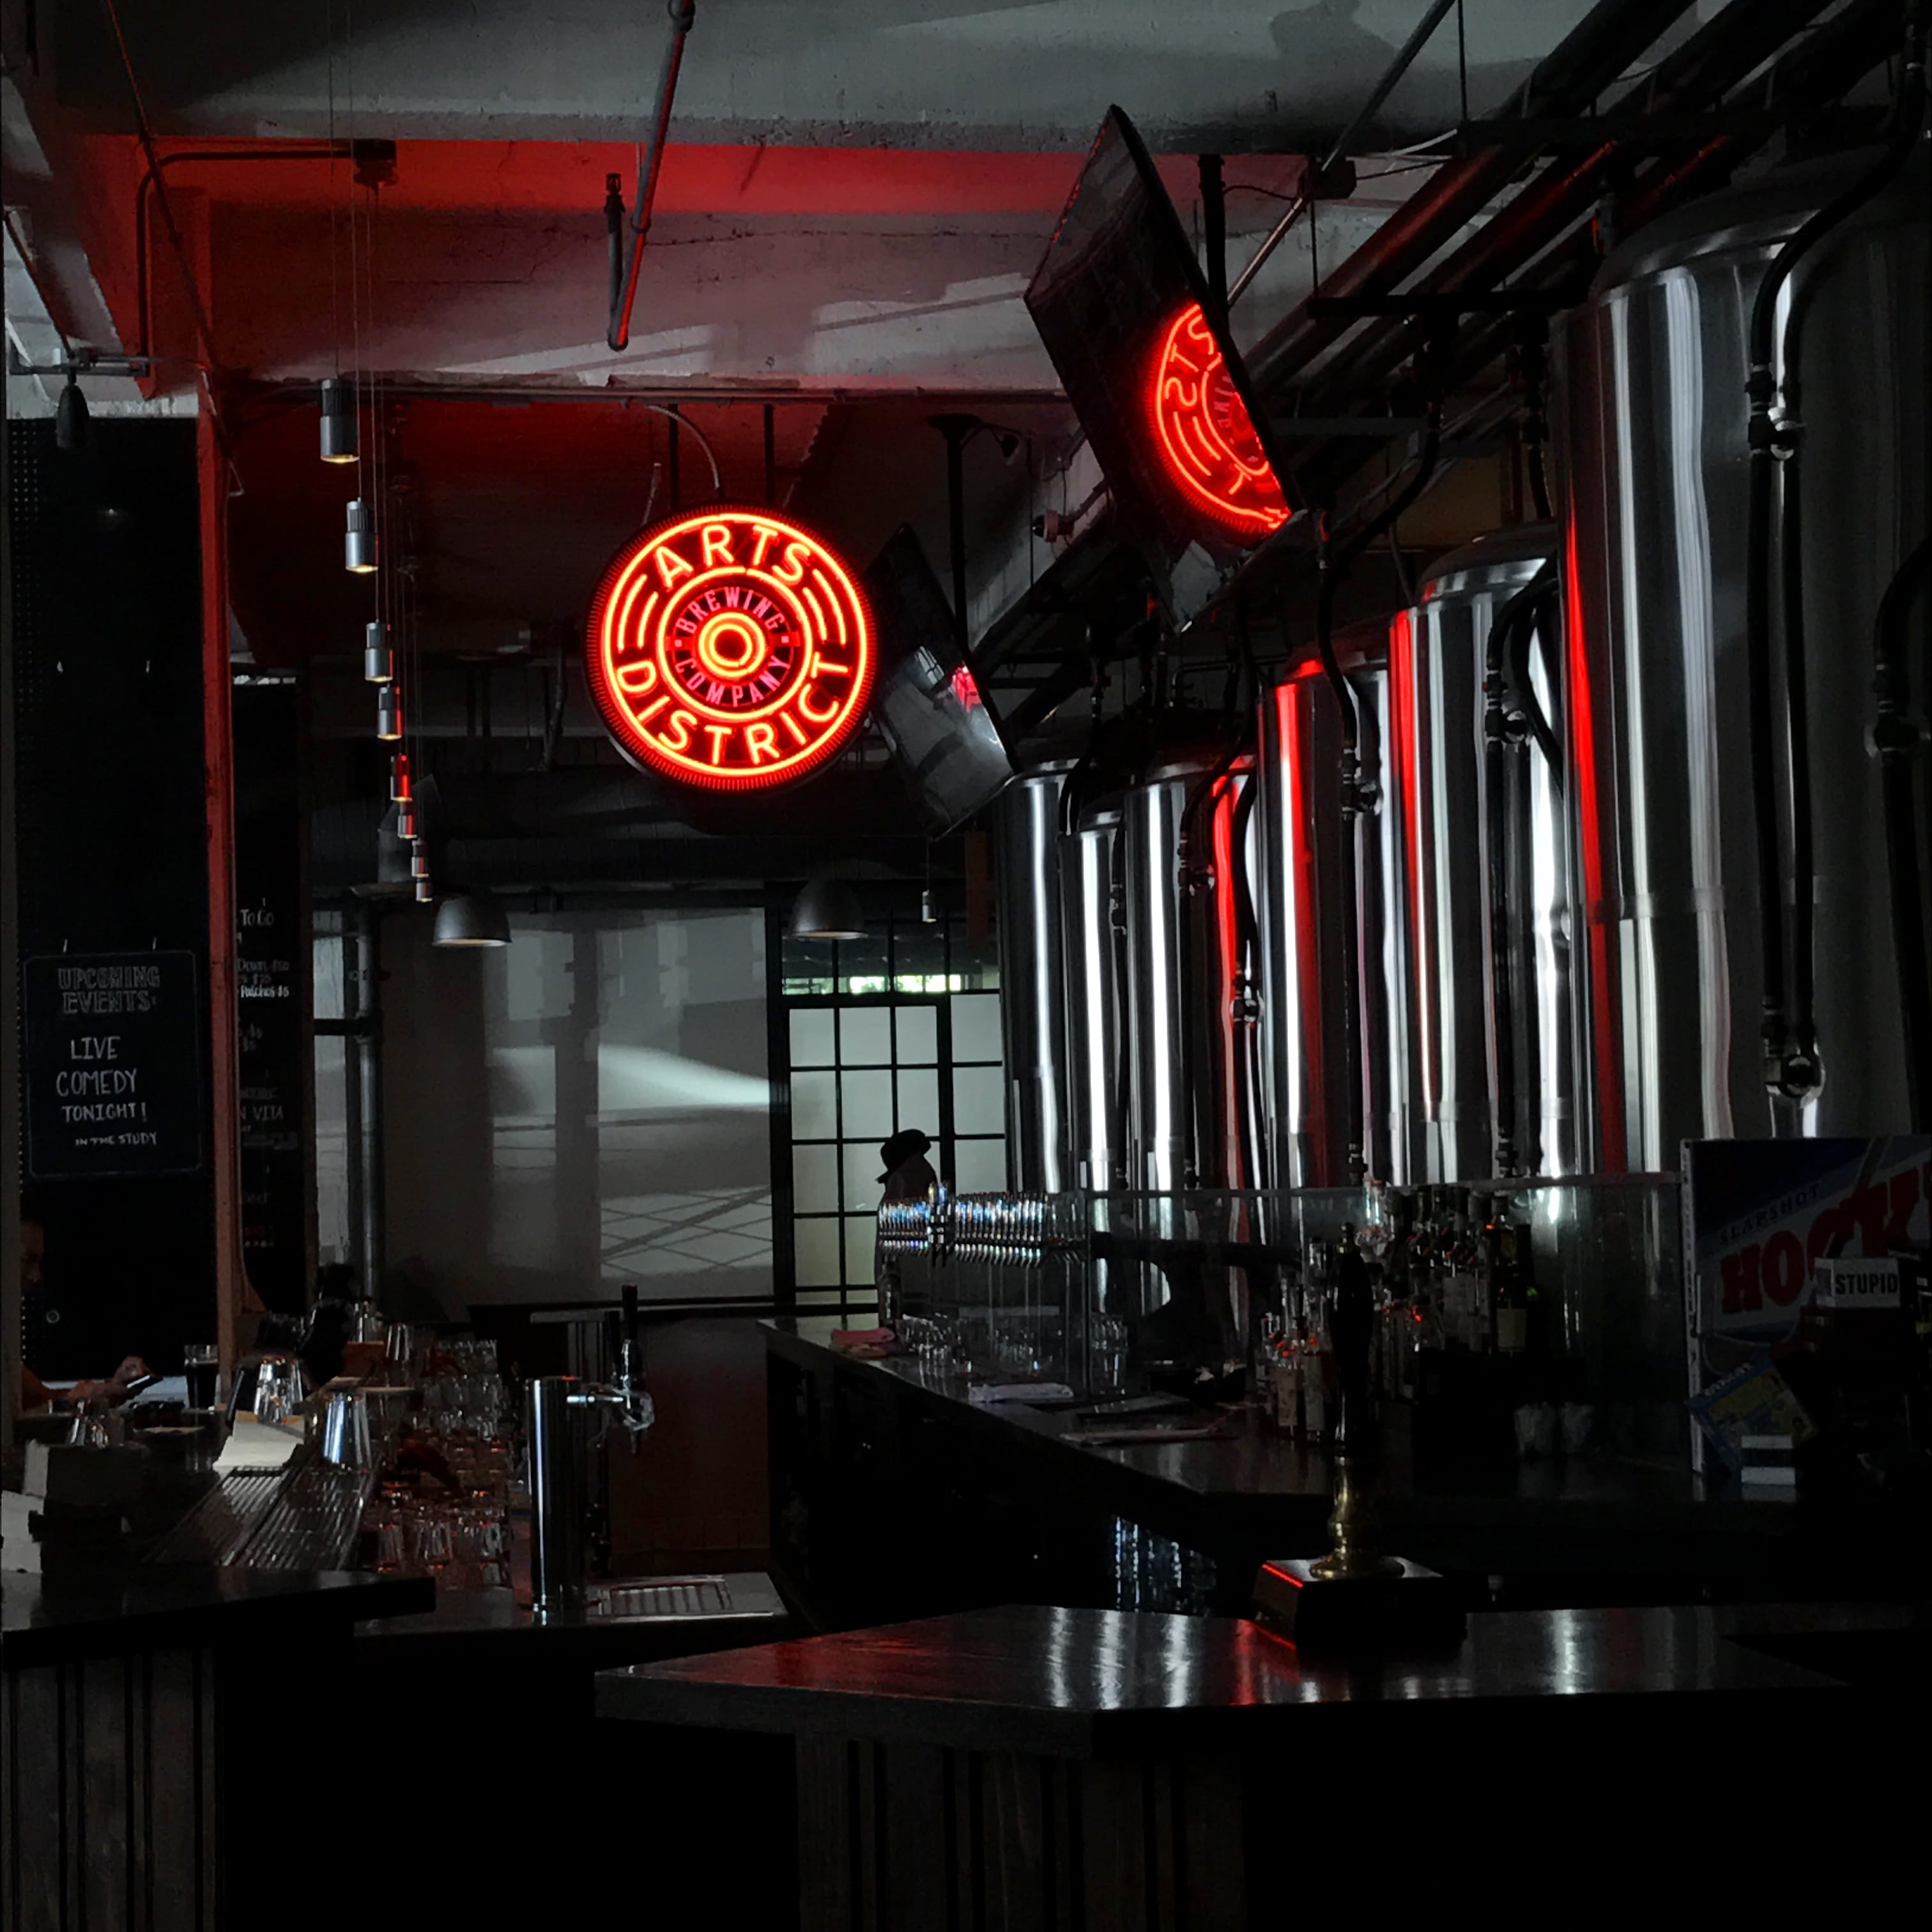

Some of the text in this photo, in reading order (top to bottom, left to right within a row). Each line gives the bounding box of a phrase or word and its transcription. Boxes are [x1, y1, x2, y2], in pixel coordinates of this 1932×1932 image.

[653, 523, 811, 588] ARTS
[677, 586, 784, 635] BREWING
[675, 655, 790, 708] COMPANY
[615, 652, 850, 765] DISTRICT
[57, 965, 160, 990] UPCOMING
[70, 1036, 121, 1061] LIVE
[56, 1068, 138, 1098] COMEDY
[118, 1131, 158, 1146] STUDY
[1835, 1272, 1899, 1295] STUPID
